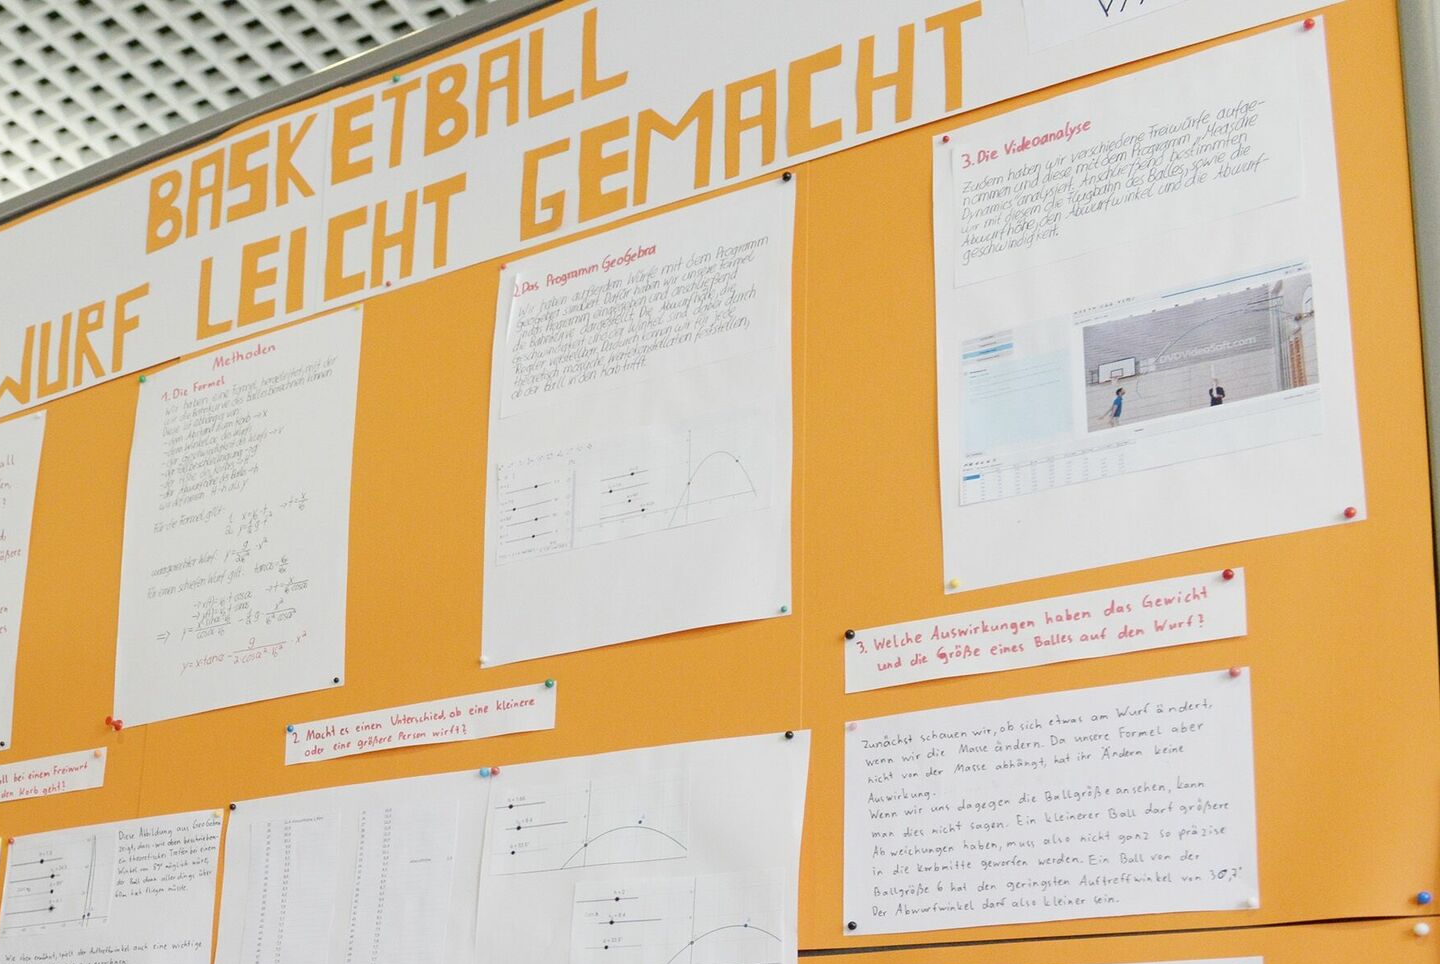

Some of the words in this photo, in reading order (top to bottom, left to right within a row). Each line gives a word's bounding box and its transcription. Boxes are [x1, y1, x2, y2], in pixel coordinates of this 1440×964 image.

[145, 8, 628, 254] BASKETBALL
[977, 150, 999, 163] Die
[1004, 121, 1091, 154] Videoanalyse
[196, 174, 467, 340] LEICHT
[520, 2, 981, 241] GEMACHT
[1008, 164, 1041, 180] haben
[1046, 154, 1066, 169] wir
[522, 281, 539, 294] Das
[546, 264, 598, 286] Programm
[602, 245, 656, 272] GeoGebra
[212, 344, 276, 370] Methoden
[173, 389, 188, 399] Die
[193, 375, 225, 392] Formel
[856, 641, 868, 654] 3.
[873, 632, 922, 650] Welche
[931, 621, 1035, 641] Auswirkungen
[1045, 609, 1091, 624] haben
[1104, 600, 1132, 617] das
[1142, 586, 1208, 608] Gewicht
[877, 657, 901, 671] und
[910, 653, 928, 666] die
[936, 645, 981, 664] Größe
[990, 643, 1024, 656] eines
[1034, 631, 1073, 648] Balles
[1080, 627, 1107, 642] auf
[1118, 625, 1144, 639] den
[1154, 614, 1204, 632] Wurf?
[304, 745, 324, 757] oder
[333, 741, 351, 751] eine
[358, 735, 392, 749] größere
[398, 731, 426, 741] Person
[432, 724, 467, 737] wirft?
[306, 725, 335, 741] Macht
[340, 727, 349, 735] es
[356, 722, 382, 731] einen
[449, 706, 462, 718] ob
[469, 705, 489, 715] eine
[496, 698, 535, 711] kleinere
[862, 734, 912, 749] Zunächst
[920, 730, 968, 742] schauen
[1000, 721, 1014, 733] ob
[1020, 719, 1042, 730] sich
[1049, 714, 1083, 726] etwas
[1091, 714, 1109, 722] am
[1116, 702, 1150, 718] Wurf
[1, 789, 14, 798] den
[19, 786, 39, 796] Korb
[43, 781, 65, 796] geht?
[14, 772, 24, 782] bei
[28, 770, 50, 780] einem
[54, 761, 88, 775] Freiwurf
